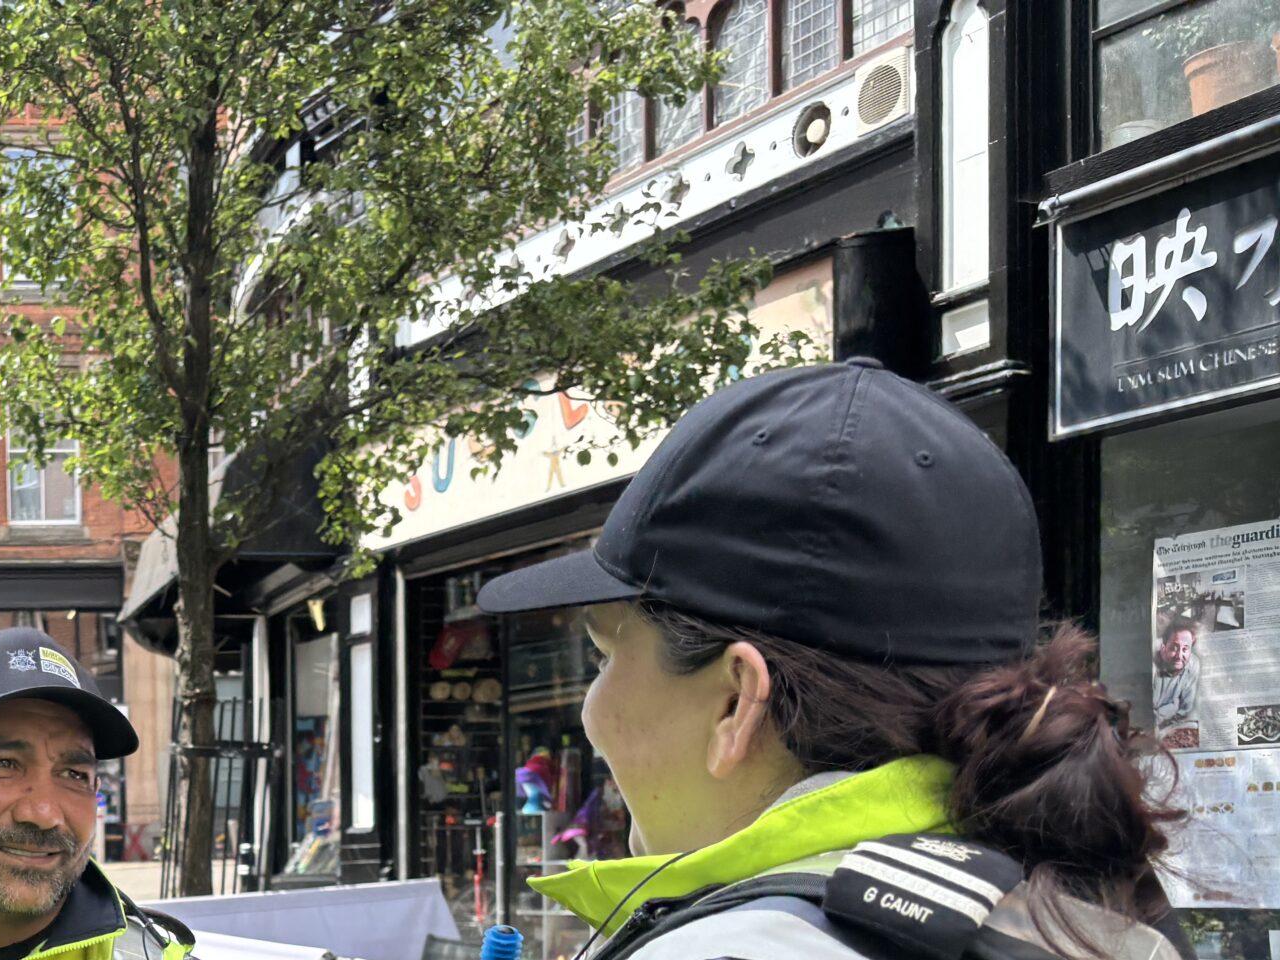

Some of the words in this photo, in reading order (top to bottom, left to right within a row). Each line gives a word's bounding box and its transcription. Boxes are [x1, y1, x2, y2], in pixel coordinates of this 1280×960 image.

[1158, 359, 1195, 380] SUM
[1199, 341, 1279, 372] CHINESE
[863, 886, 879, 903] G
[880, 892, 934, 923] CAUNT
